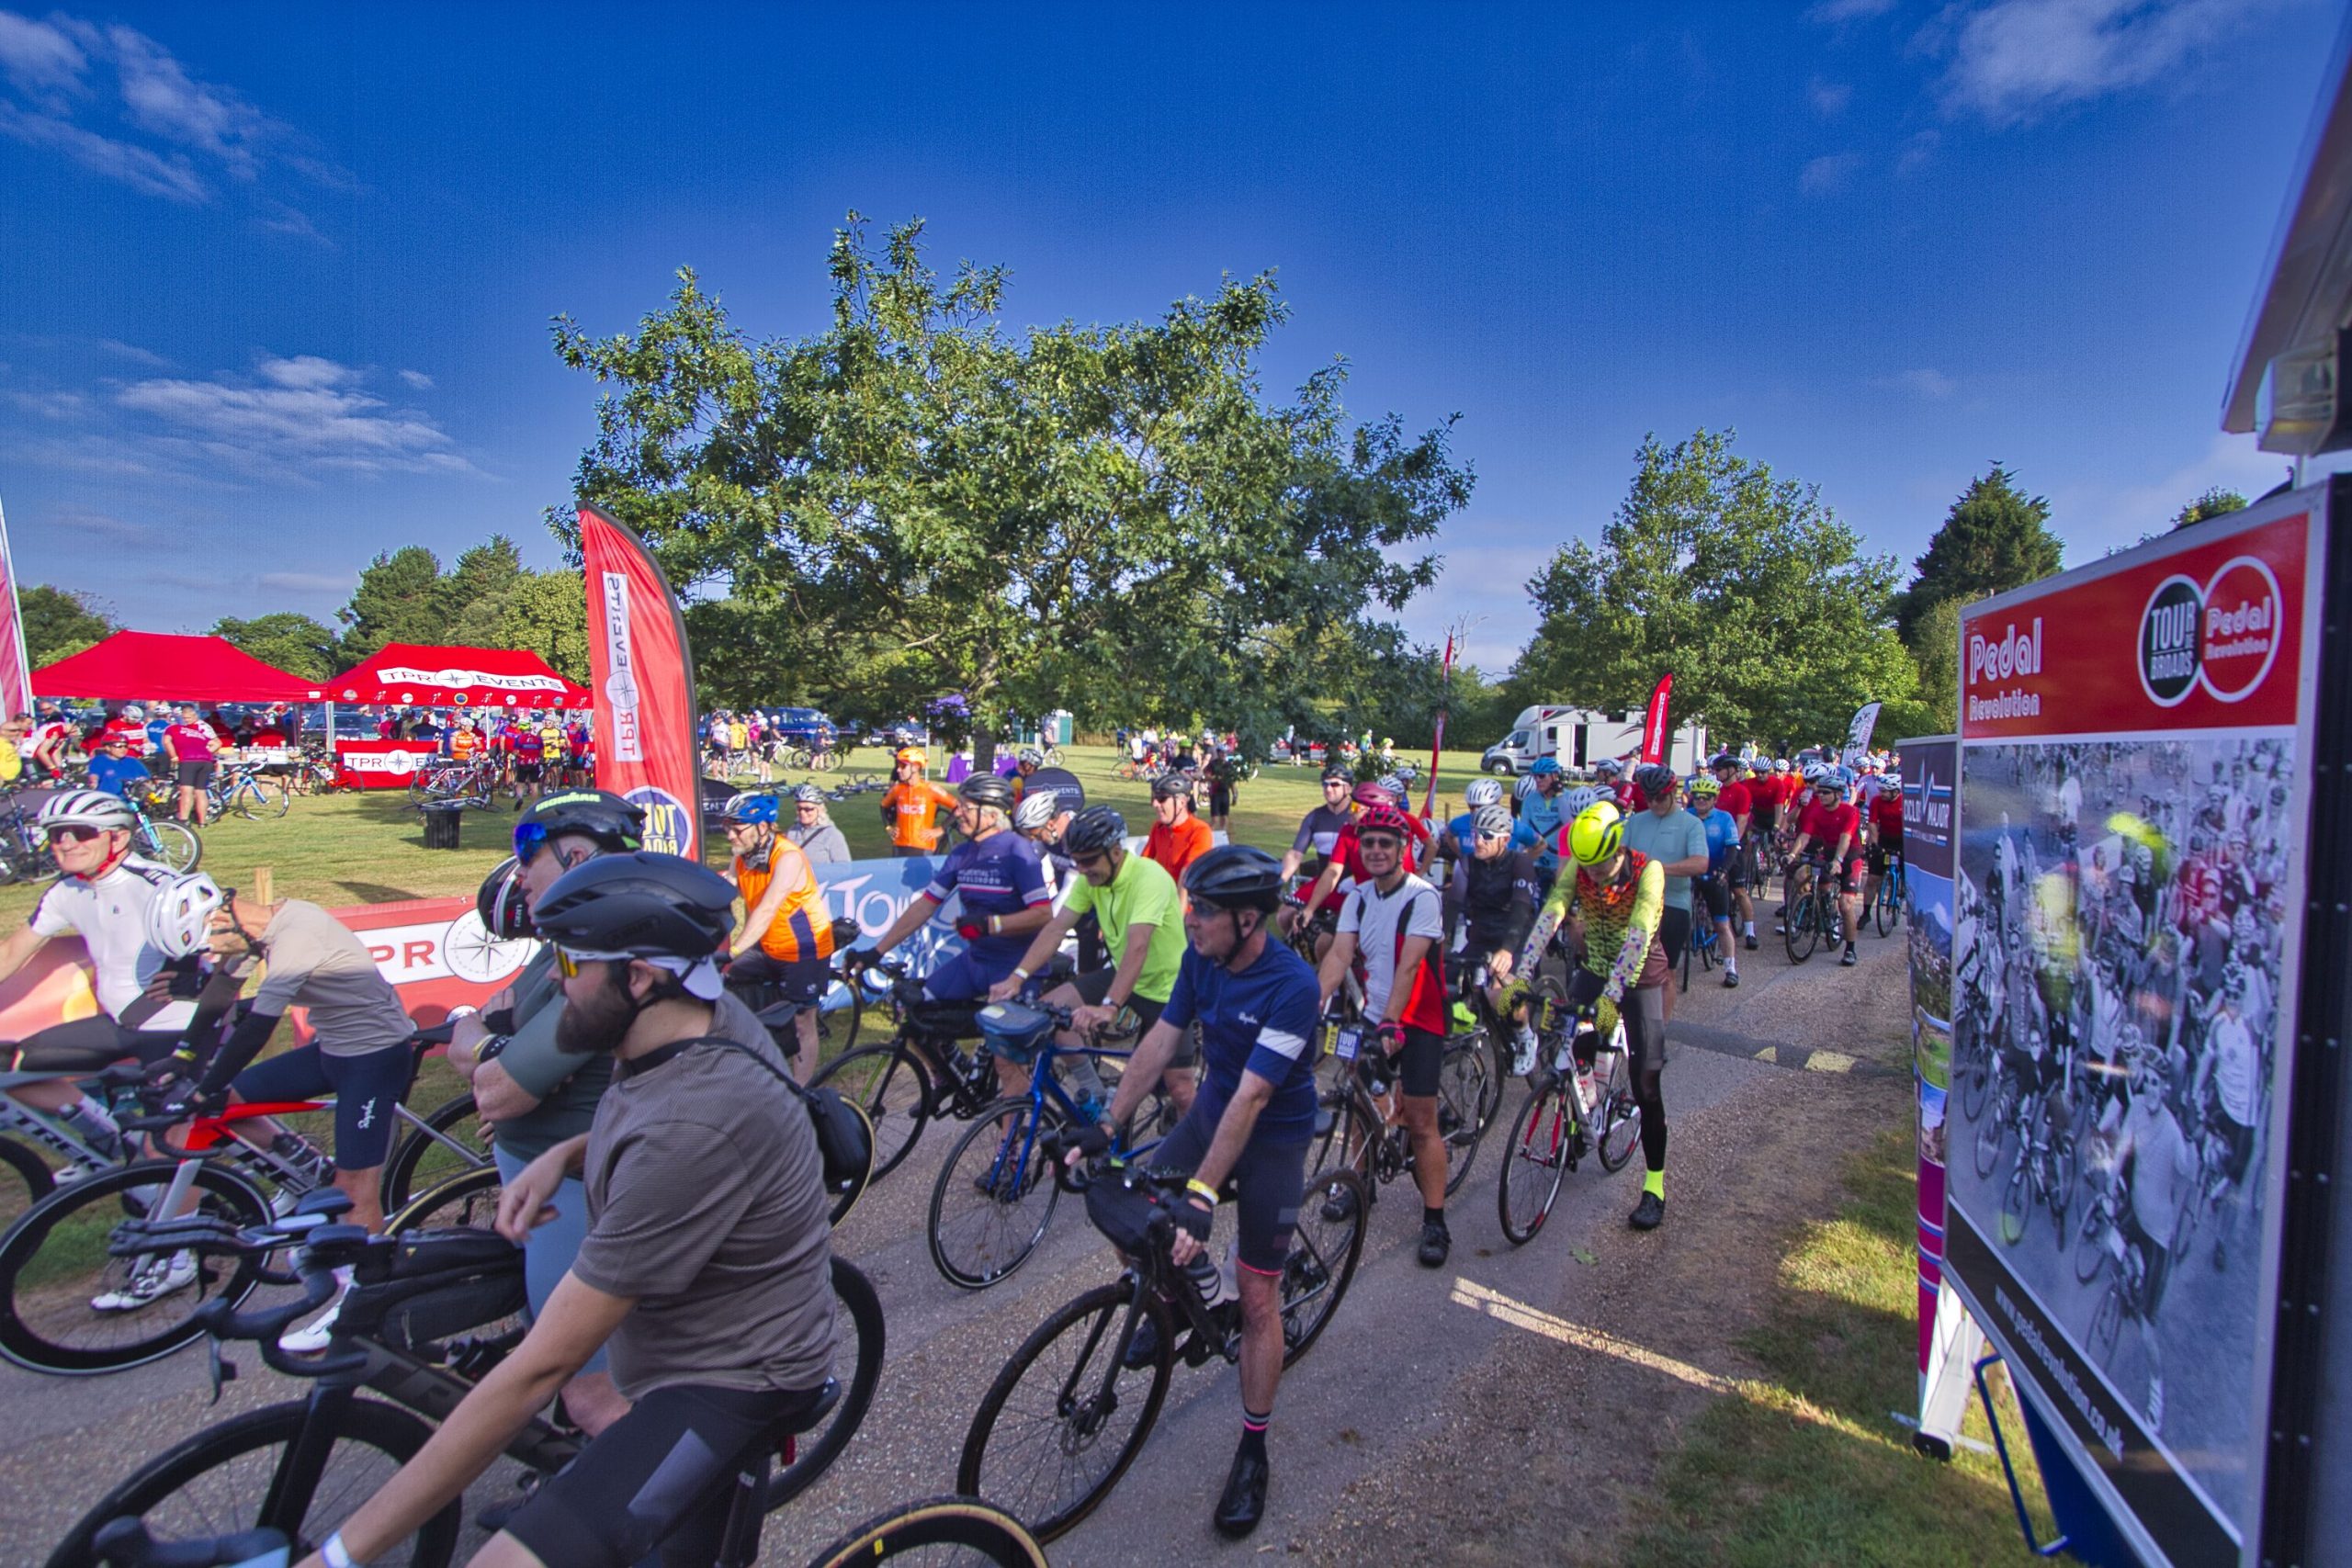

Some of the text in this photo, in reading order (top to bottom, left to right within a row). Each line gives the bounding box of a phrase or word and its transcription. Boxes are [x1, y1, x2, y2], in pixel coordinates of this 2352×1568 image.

[2150, 601, 2195, 651] TOUR
[2206, 595, 2272, 638] Pedal
[1969, 616, 2042, 685] Pedal
[2204, 636, 2270, 660] Revolution
[384, 671, 563, 690] TPR EVENTS
[1969, 688, 2041, 722] Revolution
[346, 757, 382, 768] TPR
[368, 941, 435, 969] PR
[357, 1097, 378, 1130] Rapha
